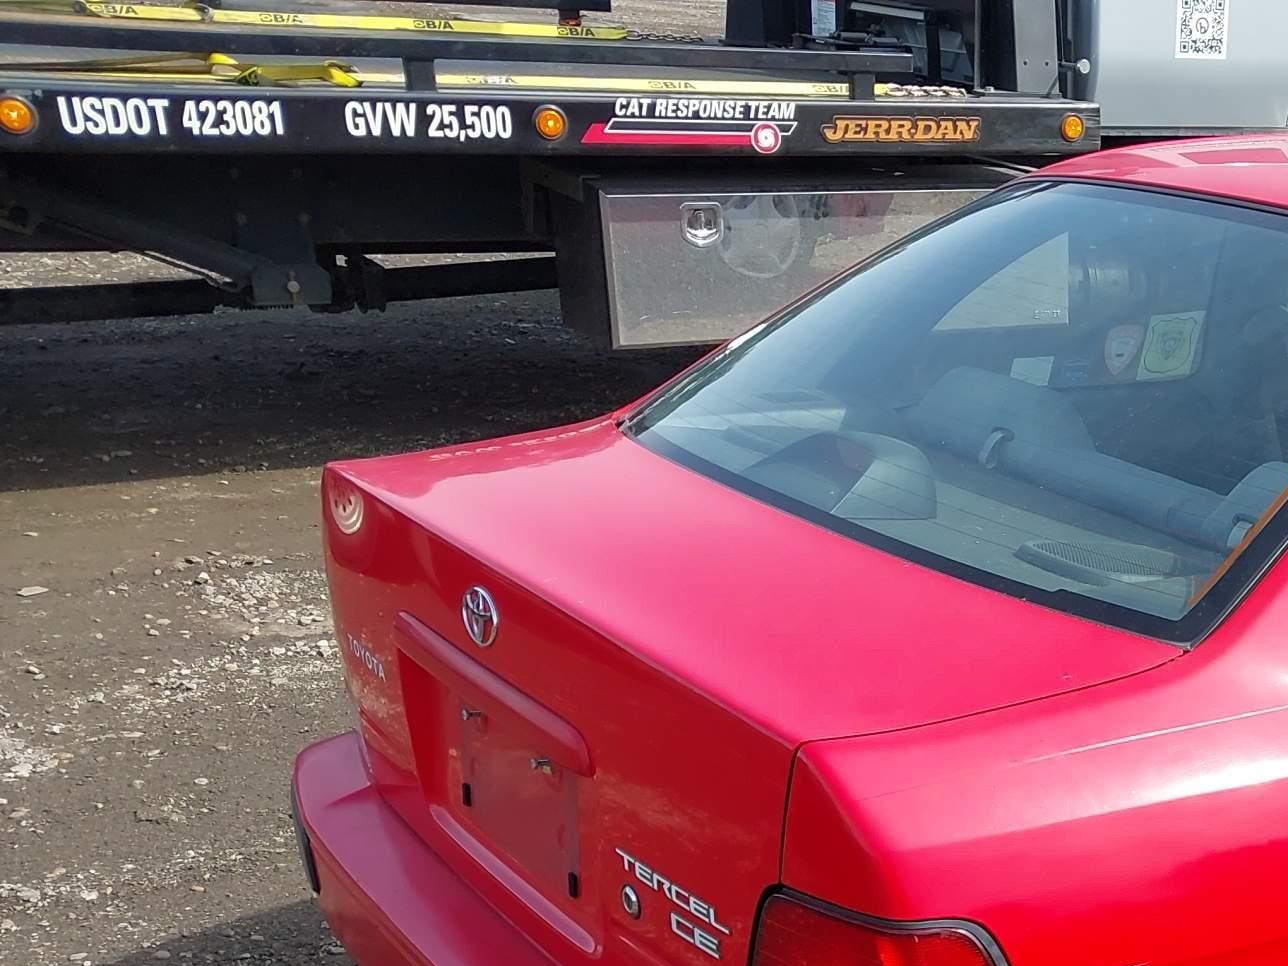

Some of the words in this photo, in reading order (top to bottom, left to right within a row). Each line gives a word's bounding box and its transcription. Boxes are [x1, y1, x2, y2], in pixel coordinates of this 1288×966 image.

[56, 96, 169, 136] USDOT
[182, 100, 284, 136] 423081
[344, 101, 416, 137] GVW
[425, 103, 512, 142] 25,500
[614, 98, 652, 116] CAT
[655, 99, 744, 119] RESPONSE
[748, 102, 797, 120] TEAM
[346, 632, 386, 683] TOYOTA
[615, 847, 732, 935] TERCEL
[670, 912, 721, 960] CE
